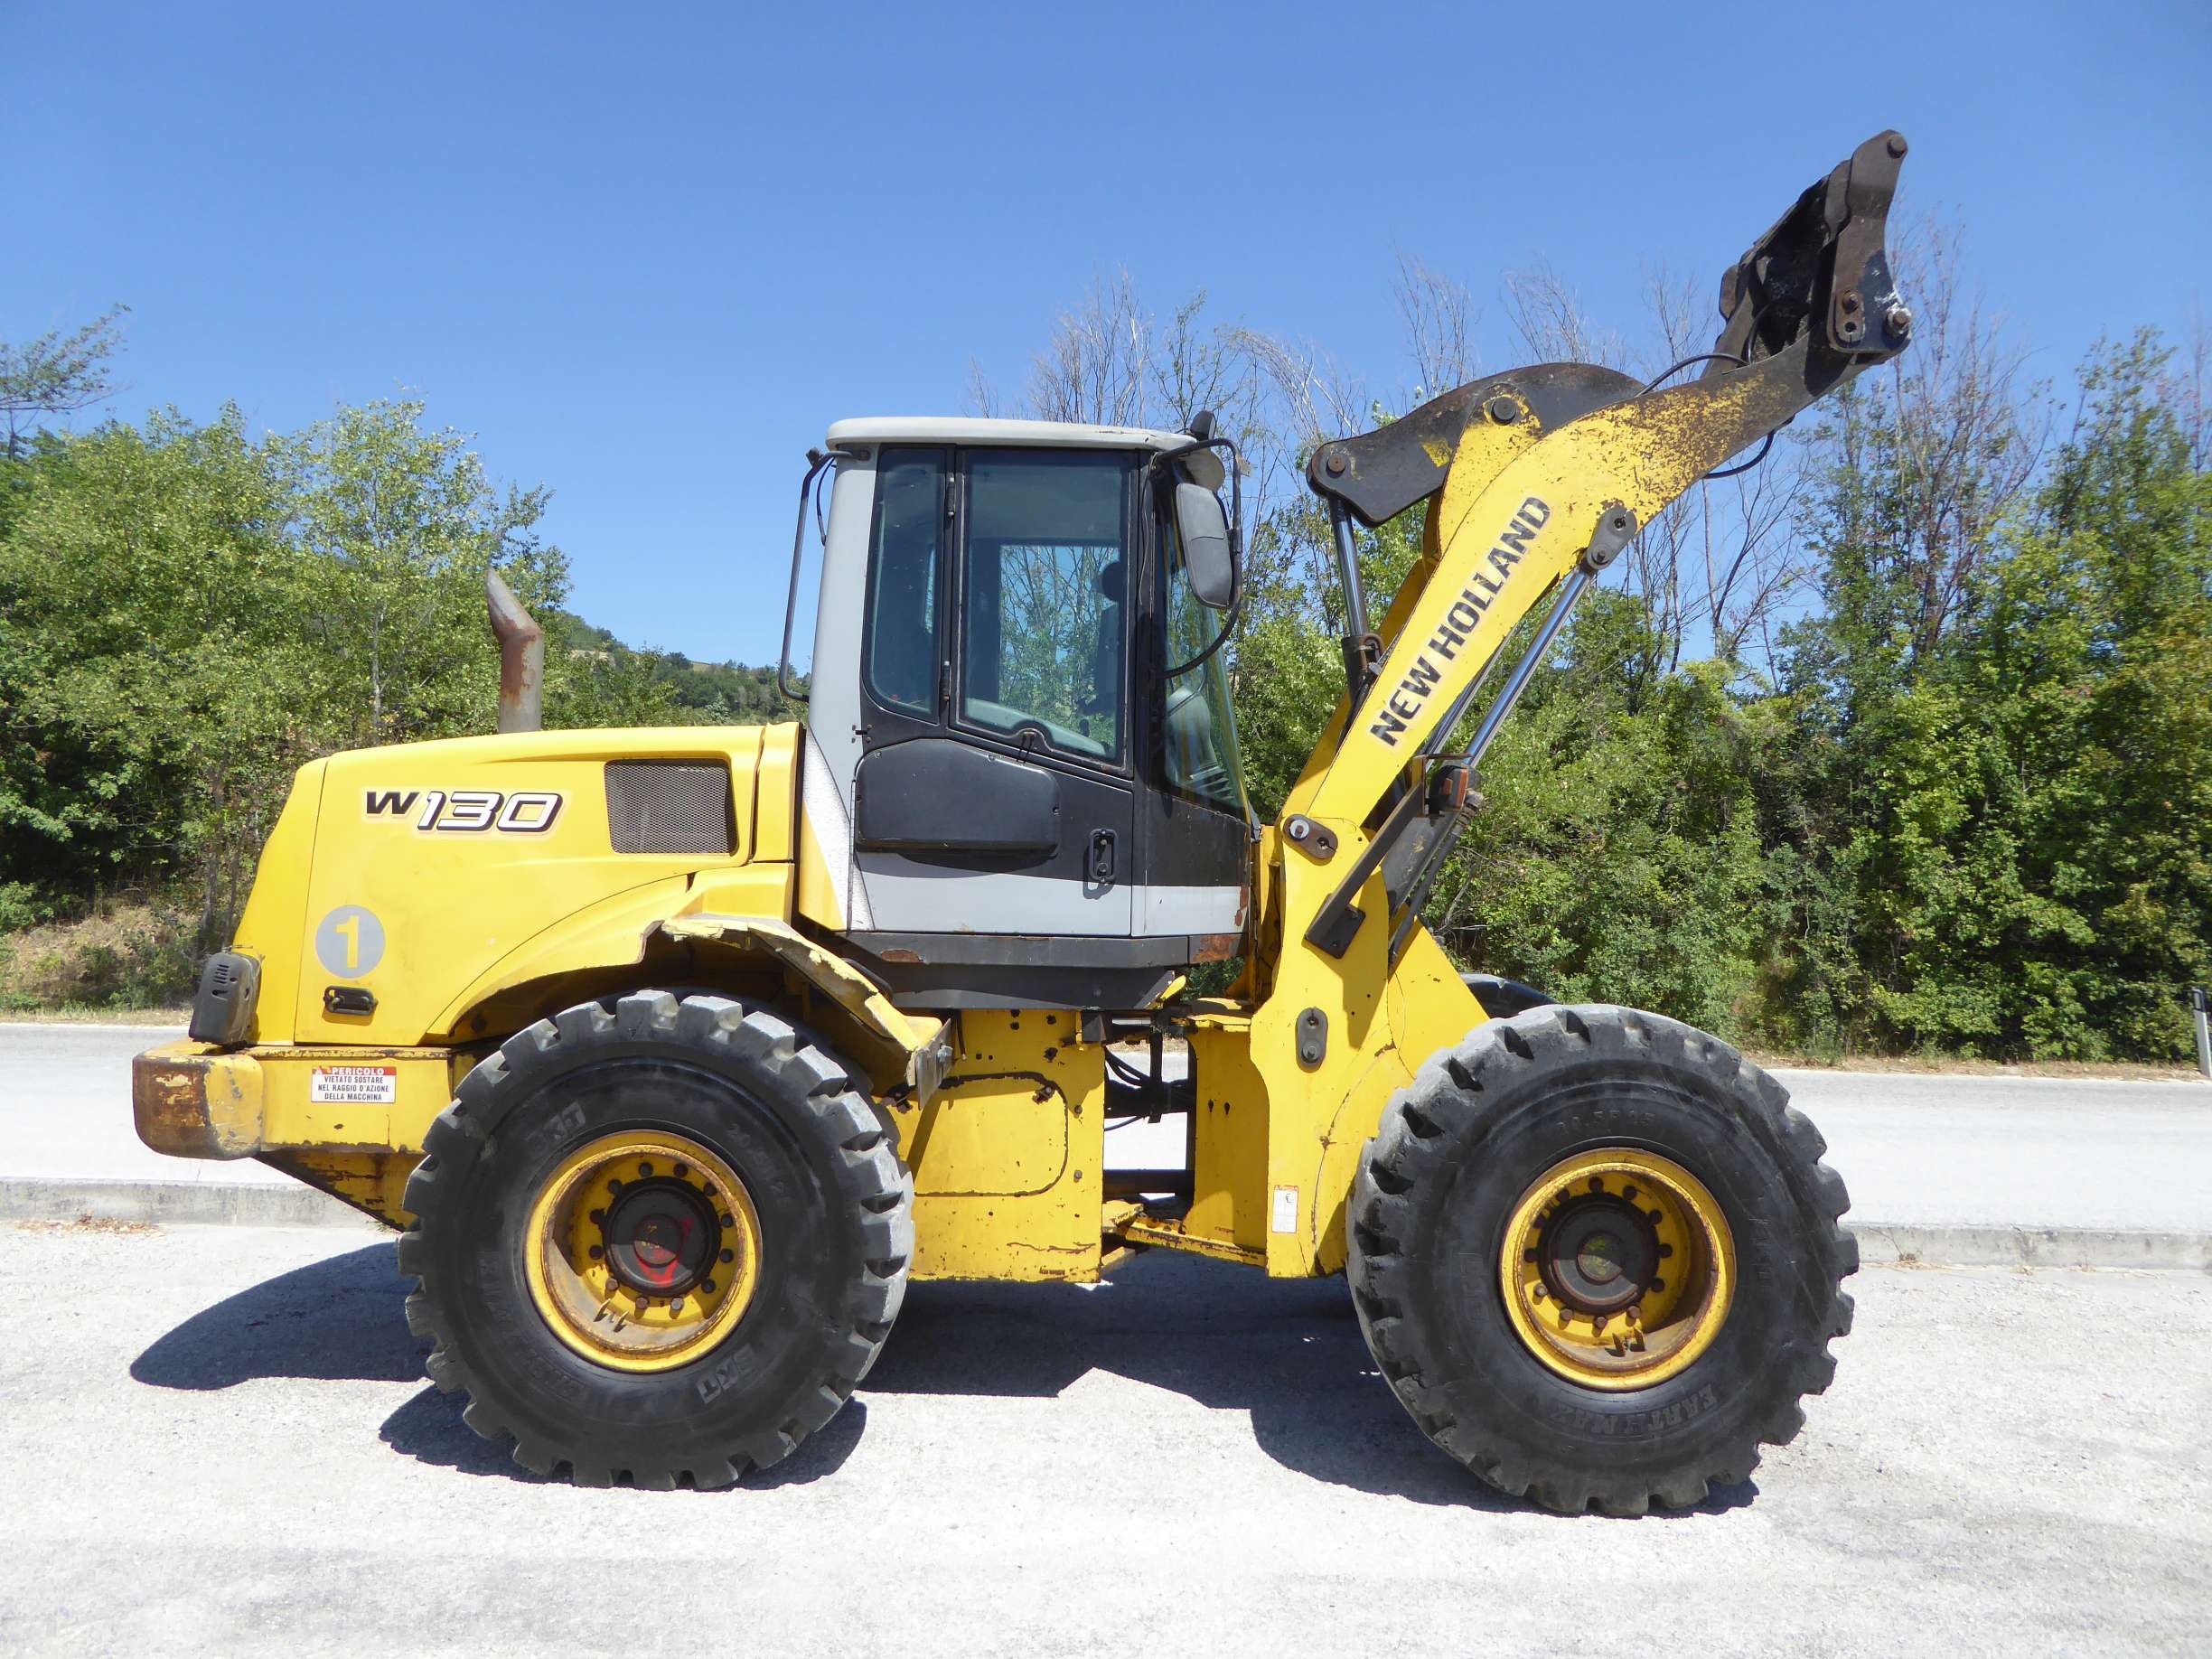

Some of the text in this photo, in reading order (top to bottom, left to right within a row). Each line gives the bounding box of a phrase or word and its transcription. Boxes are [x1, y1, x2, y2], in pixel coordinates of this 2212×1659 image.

[1370, 497, 1551, 746] NEW HOLLAND
[335, 914, 359, 969] 1
[332, 1067, 384, 1075] PERICOLO
